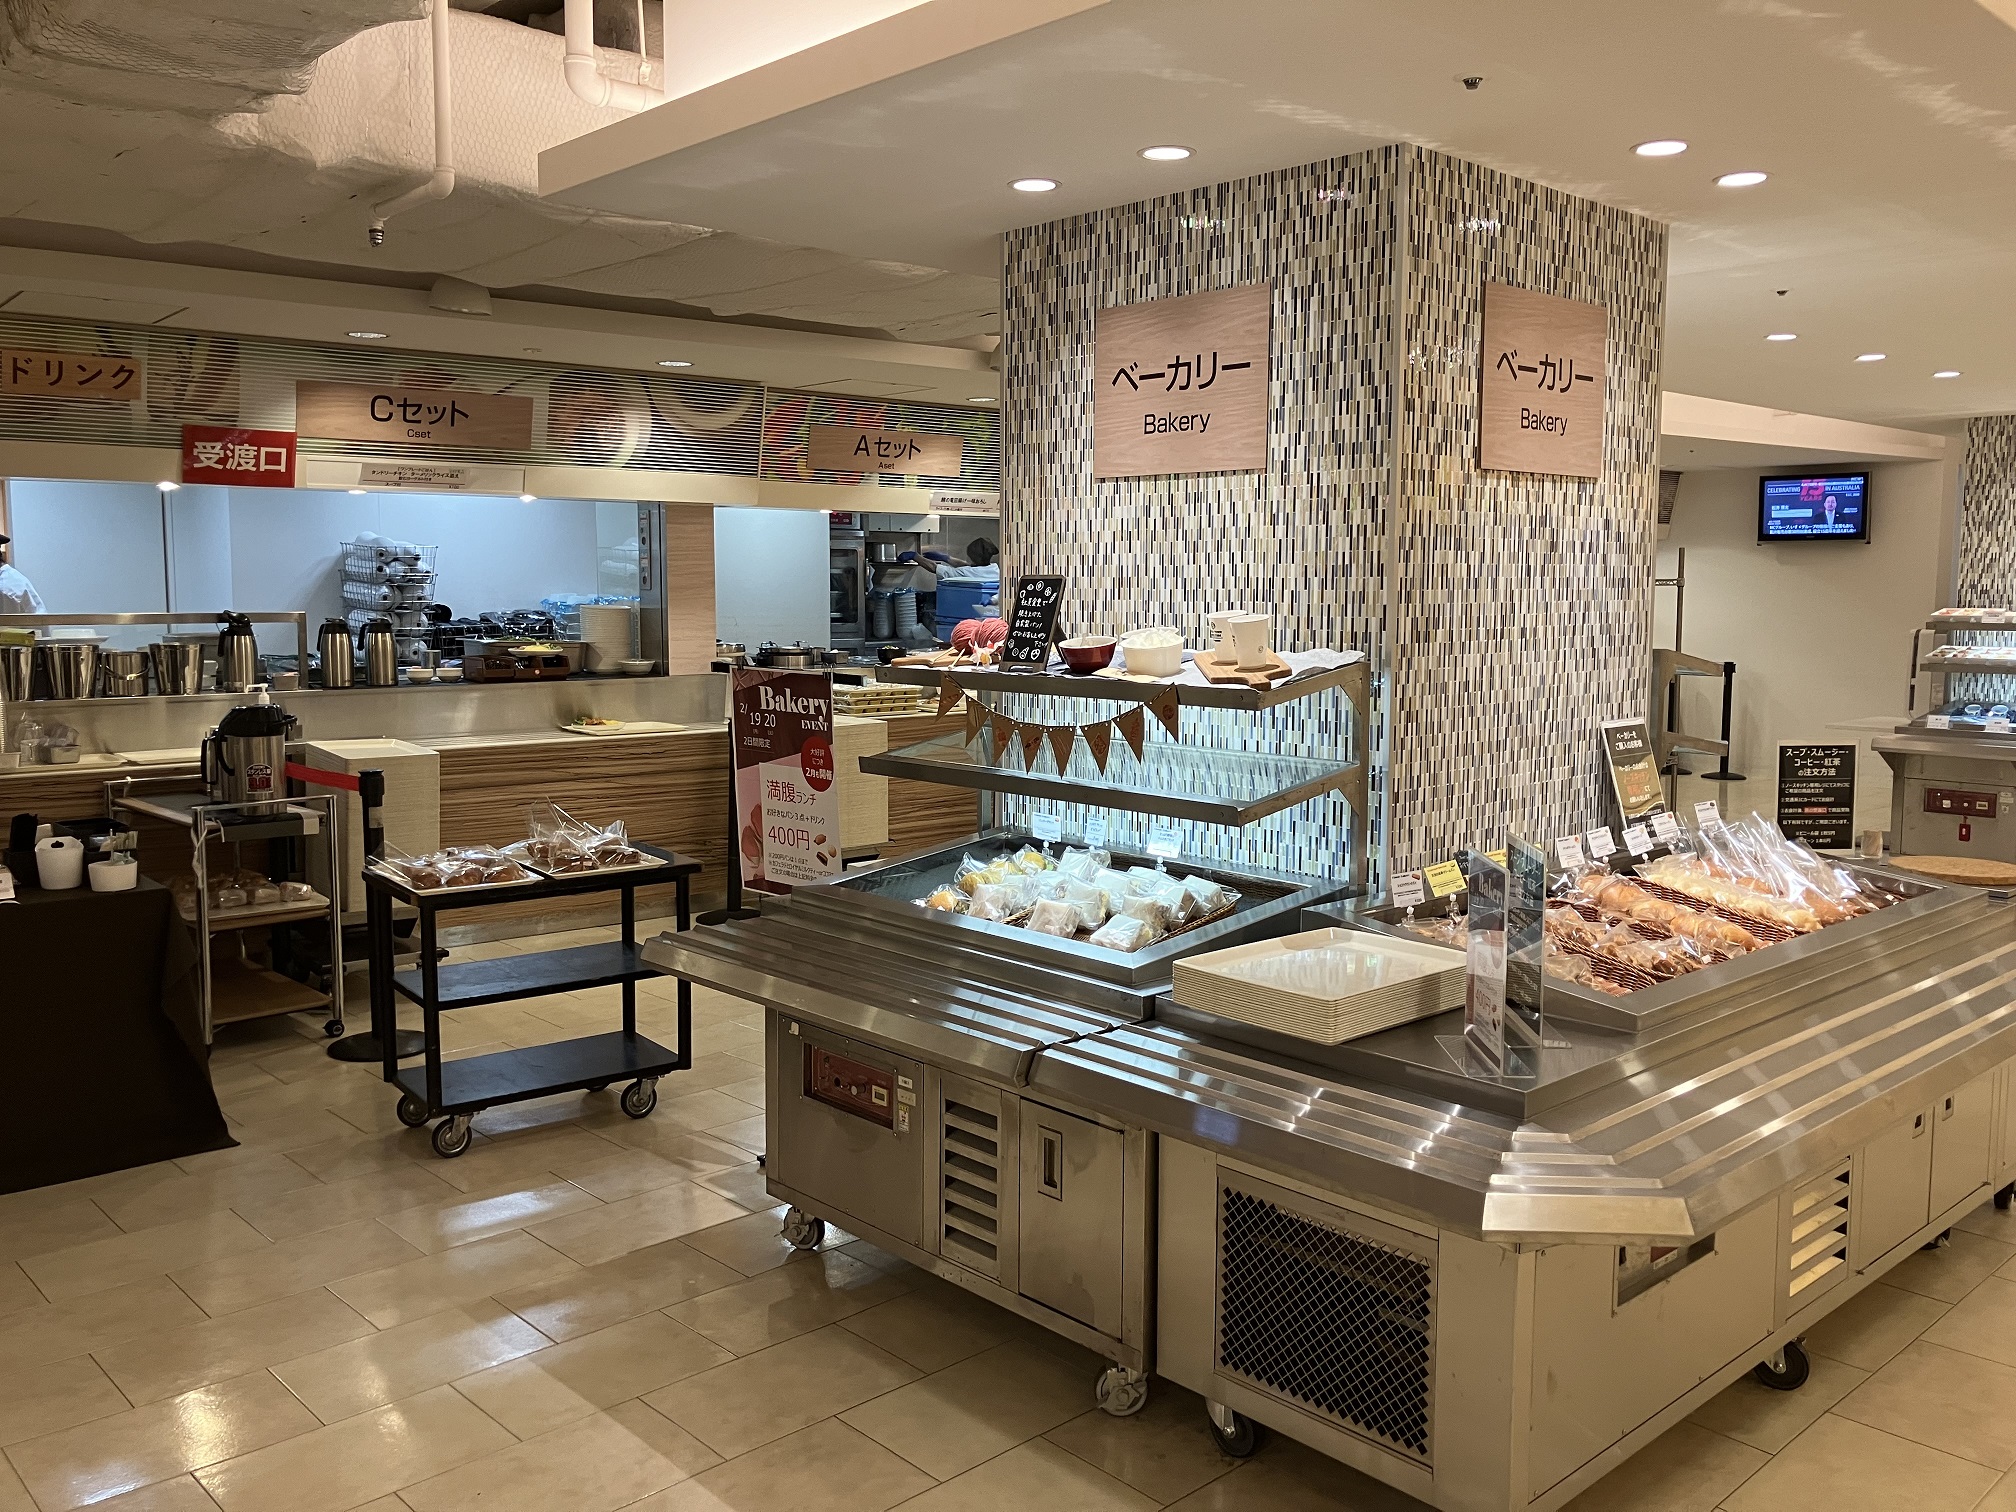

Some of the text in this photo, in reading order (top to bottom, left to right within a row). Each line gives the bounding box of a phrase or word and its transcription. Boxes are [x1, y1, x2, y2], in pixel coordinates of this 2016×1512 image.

[12, 356, 135, 390] ドリンク
[1112, 351, 1251, 392] ベーカリー
[1496, 349, 1594, 393] ベーカリー
[370, 394, 470, 427] Cセット
[1143, 412, 1211, 435] Bakery
[1520, 407, 1568, 437] Bakery
[407, 428, 431, 439] Cset
[192, 441, 287, 473] 受渡口
[853, 434, 922, 460] Aセット
[878, 461, 895, 470] Aset
[758, 685, 830, 723] Bakery
[801, 719, 830, 731] EVENT
[743, 736, 772, 749] 2日間限定
[1794, 758, 1841, 766] コーヒー・紅茶
[1798, 768, 1836, 776] の注文方法
[766, 779, 817, 806] 満腹ランチ
[768, 825, 811, 851] 400円
